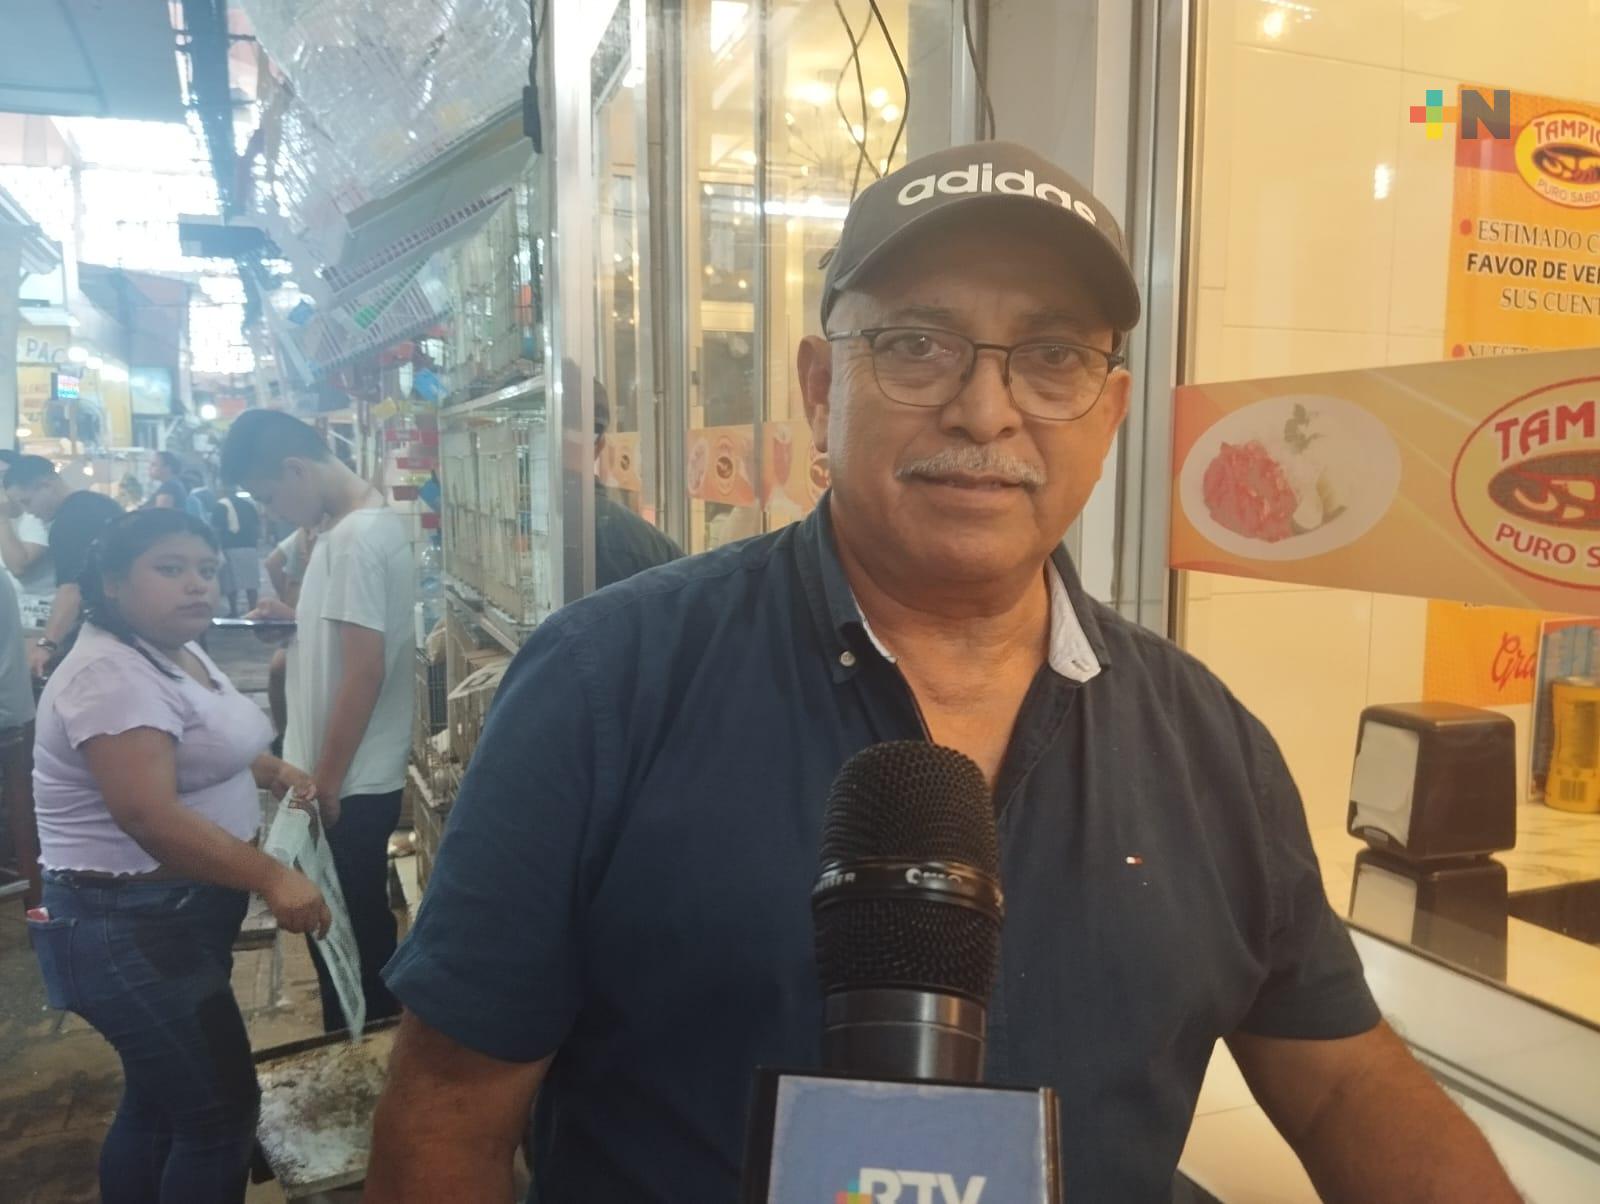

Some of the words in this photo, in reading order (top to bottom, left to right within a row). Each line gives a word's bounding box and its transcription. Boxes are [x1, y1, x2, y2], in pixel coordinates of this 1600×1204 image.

[1537, 178, 1568, 201] PURO
[1478, 219, 1582, 251] ESTIMADO
[1467, 253, 1538, 278] FAVOR
[1542, 260, 1568, 281] DE
[1572, 263, 1600, 285] VE
[1501, 288, 1538, 311] SUS
[1496, 522, 1576, 564] PURO
